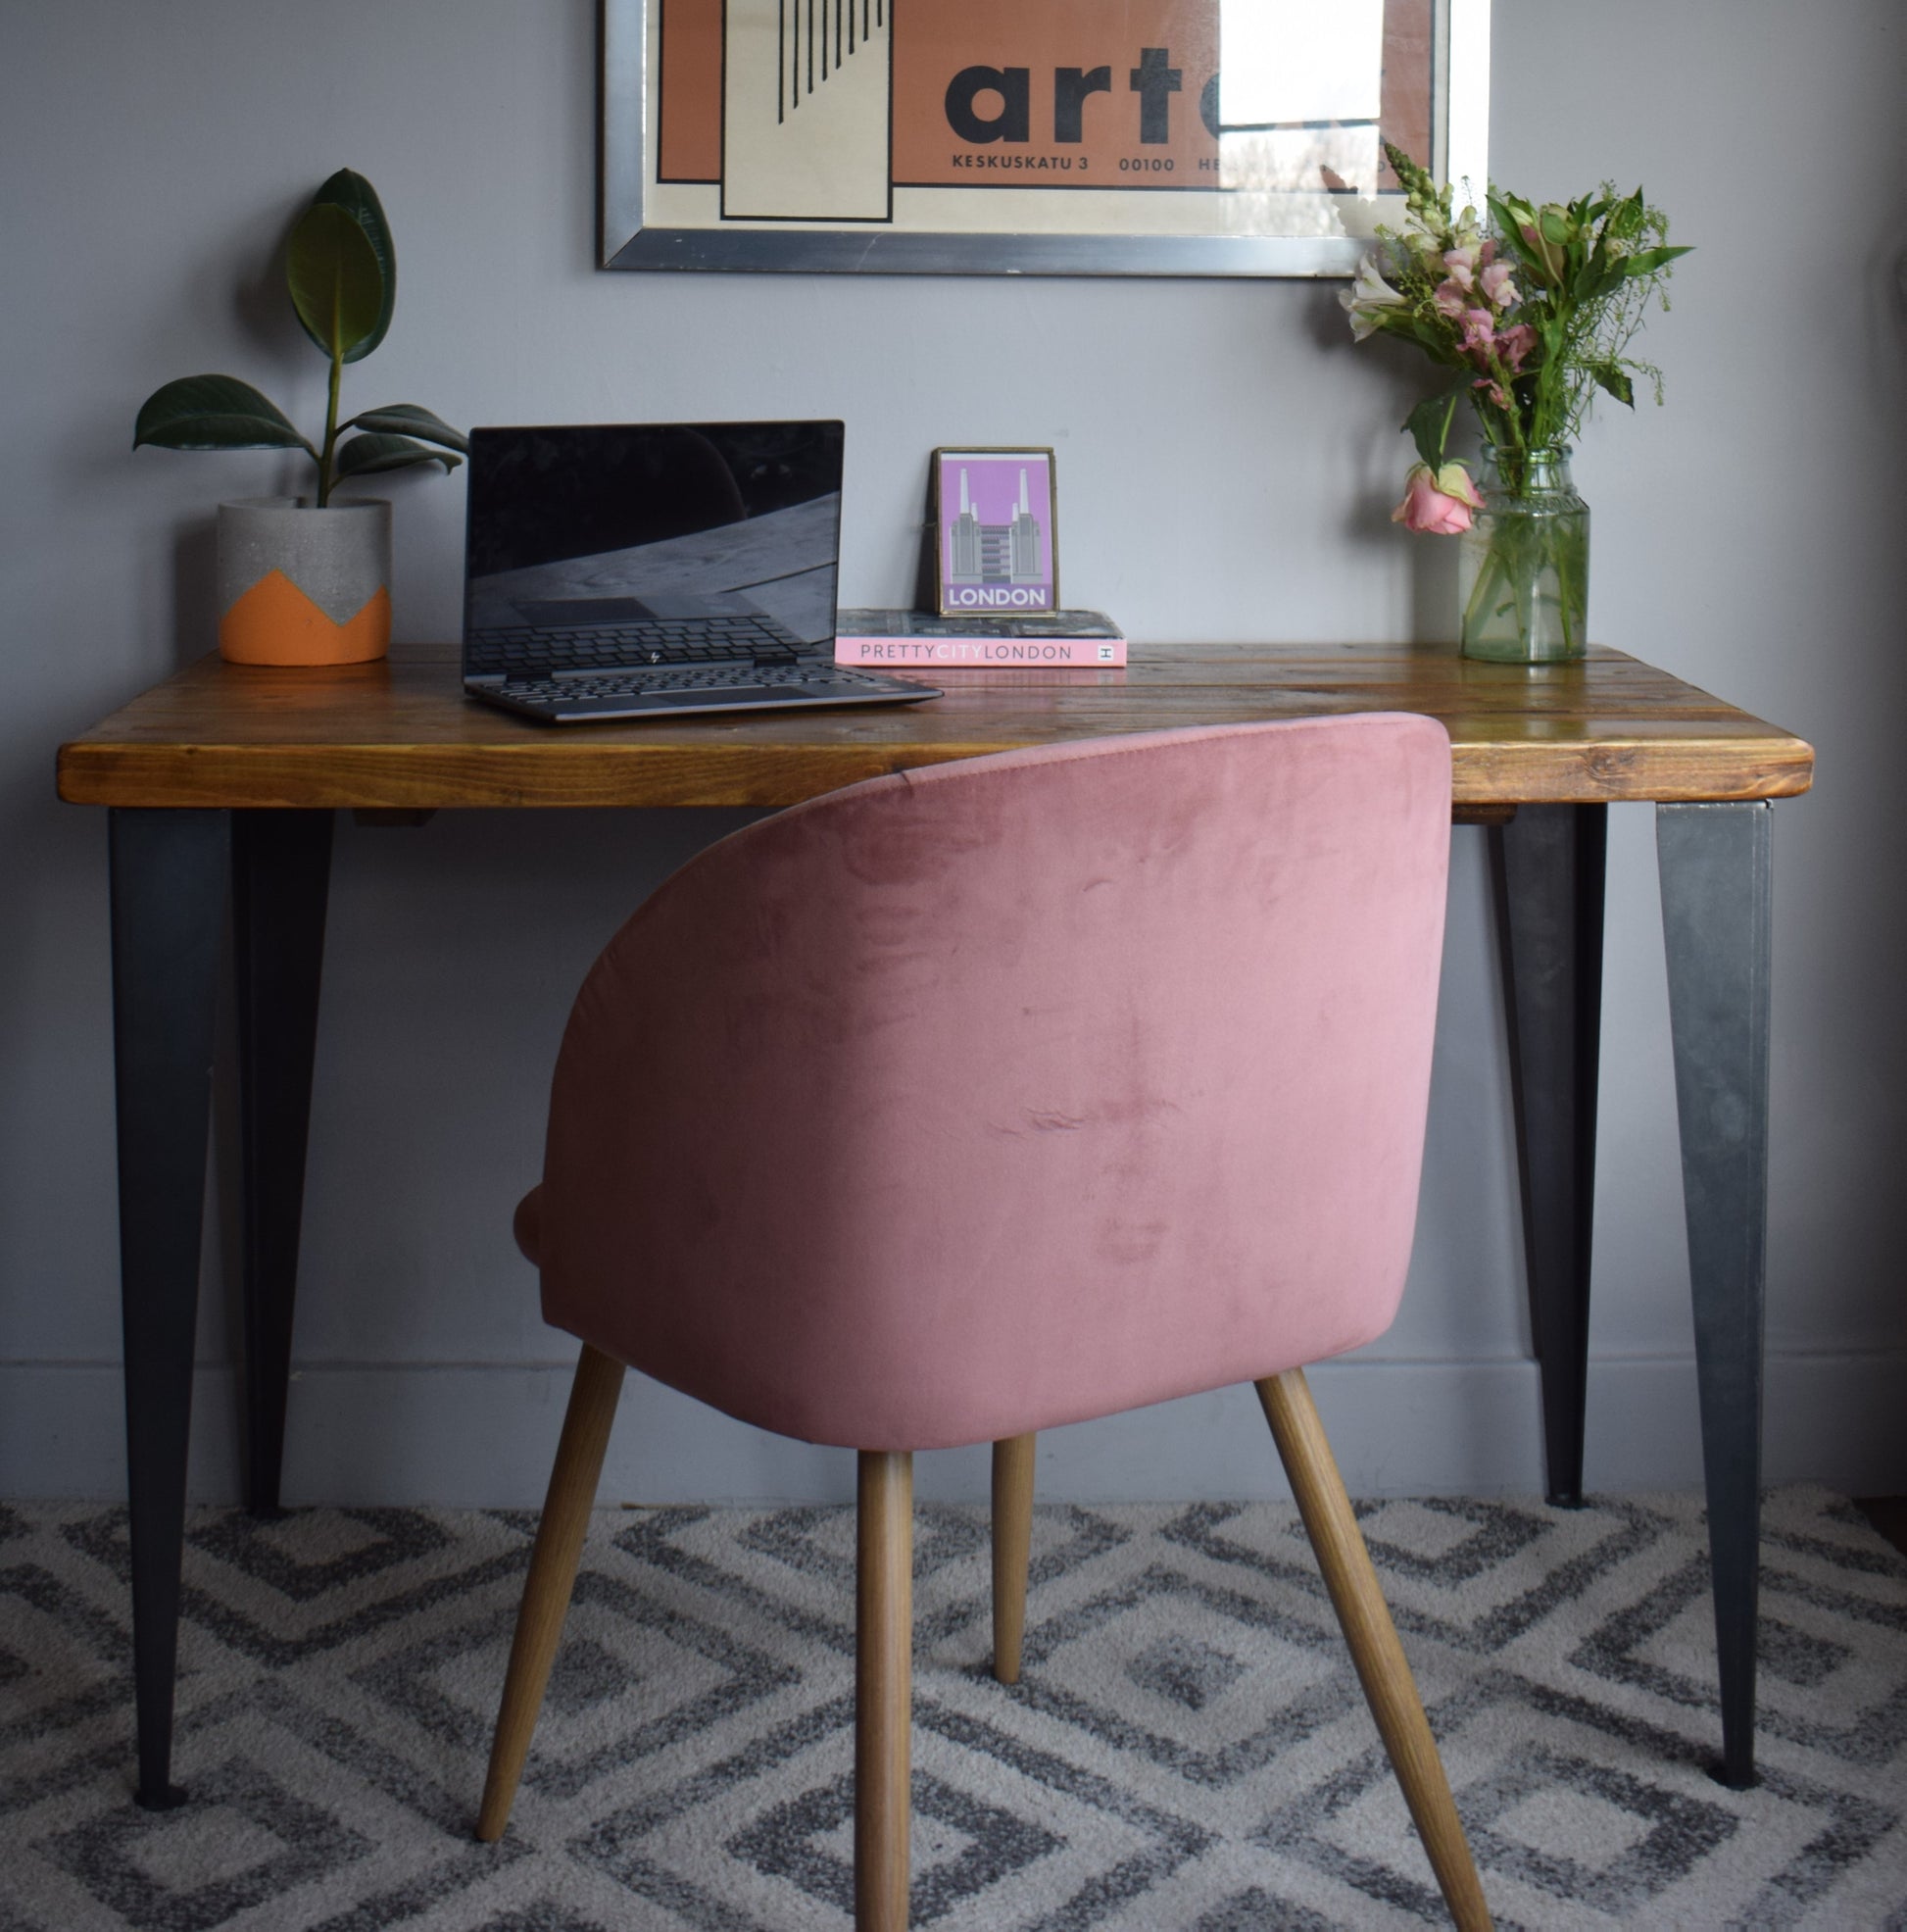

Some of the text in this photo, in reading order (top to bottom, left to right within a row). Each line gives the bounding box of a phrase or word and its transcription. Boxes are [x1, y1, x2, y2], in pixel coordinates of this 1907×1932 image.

[945, 47, 1386, 147] art
[953, 154, 1174, 172] KESKUSKATU 3 00100
[949, 588, 1046, 606] LONDON
